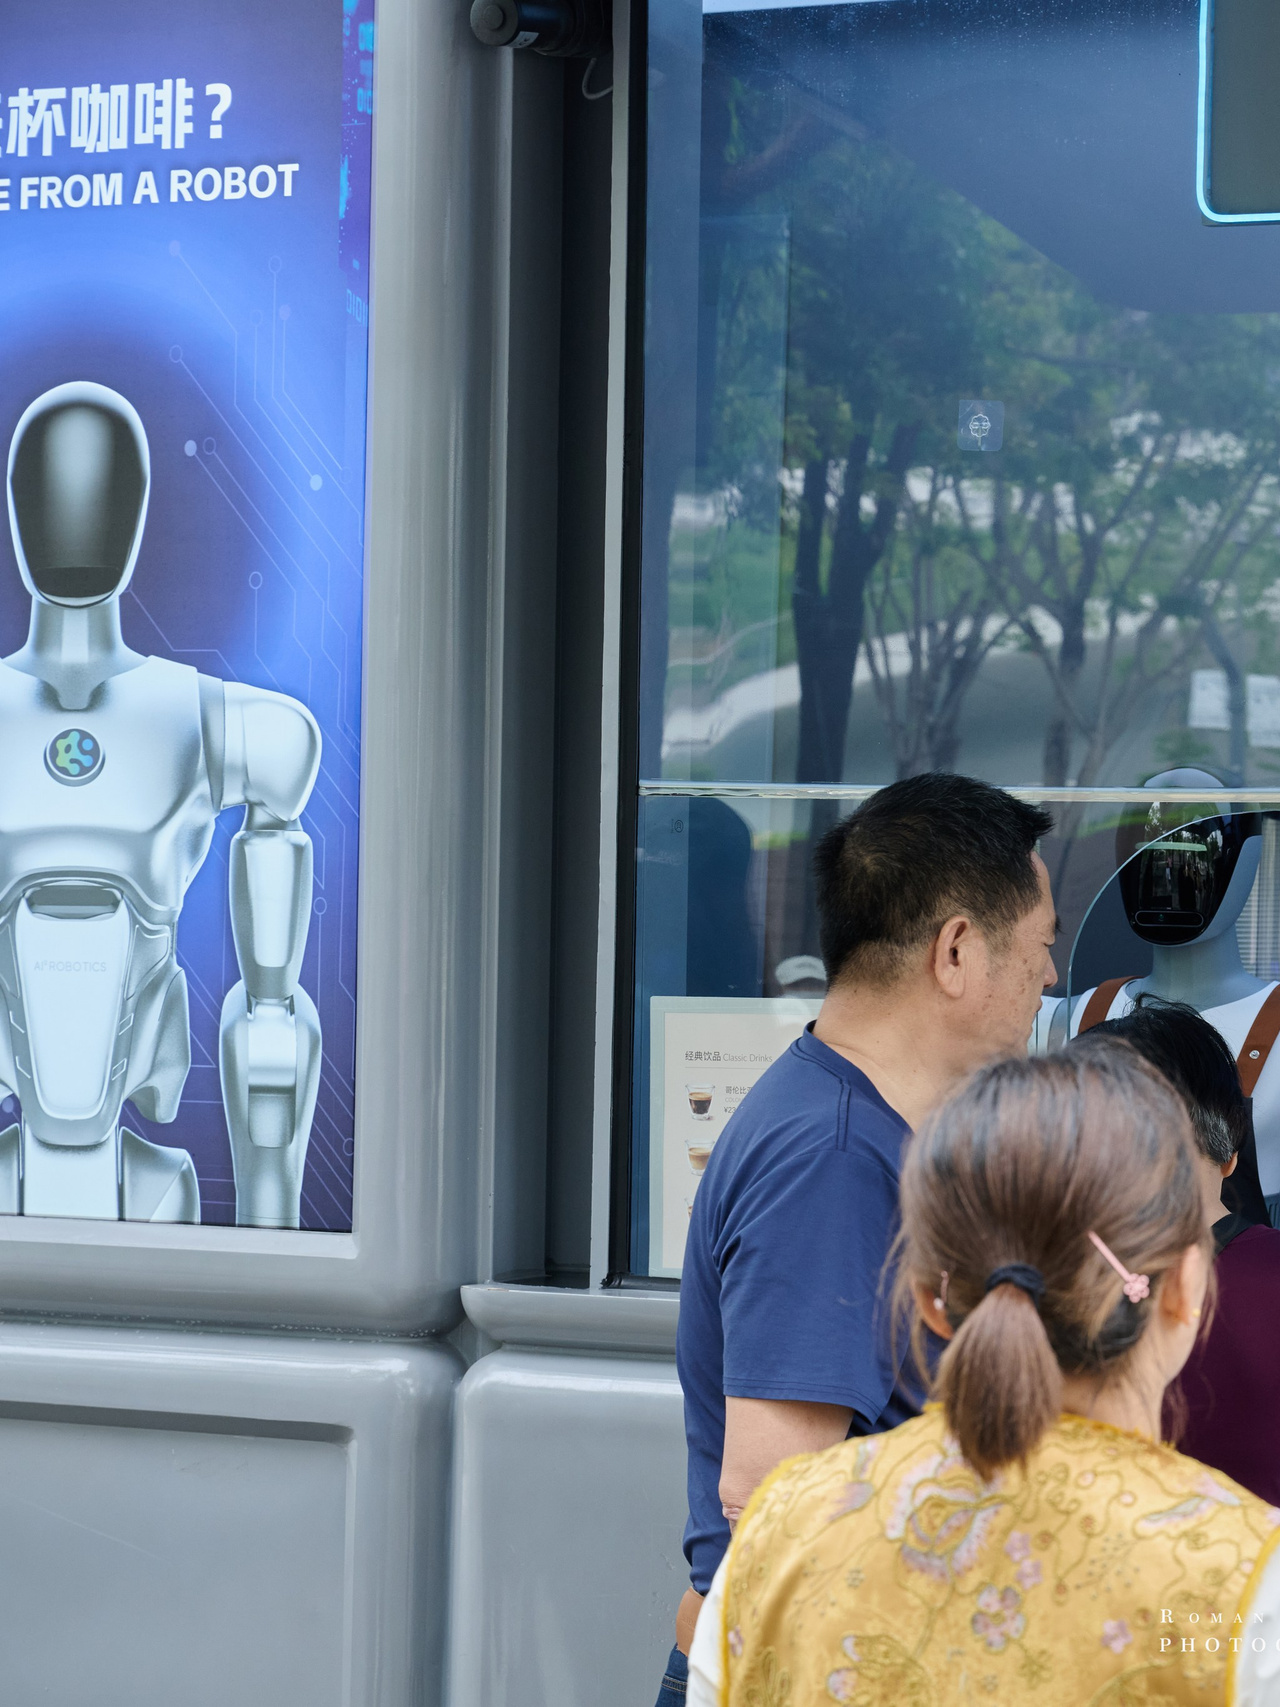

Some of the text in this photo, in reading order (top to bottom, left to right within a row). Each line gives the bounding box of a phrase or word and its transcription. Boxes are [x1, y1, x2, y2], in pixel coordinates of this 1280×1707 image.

[0, 78, 233, 158] 杯咖啡?
[20, 172, 123, 210] FROM
[133, 171, 160, 204] A
[169, 163, 300, 202] ROBOT
[685, 1051, 773, 1063] 经典饮品 Classic Drinks
